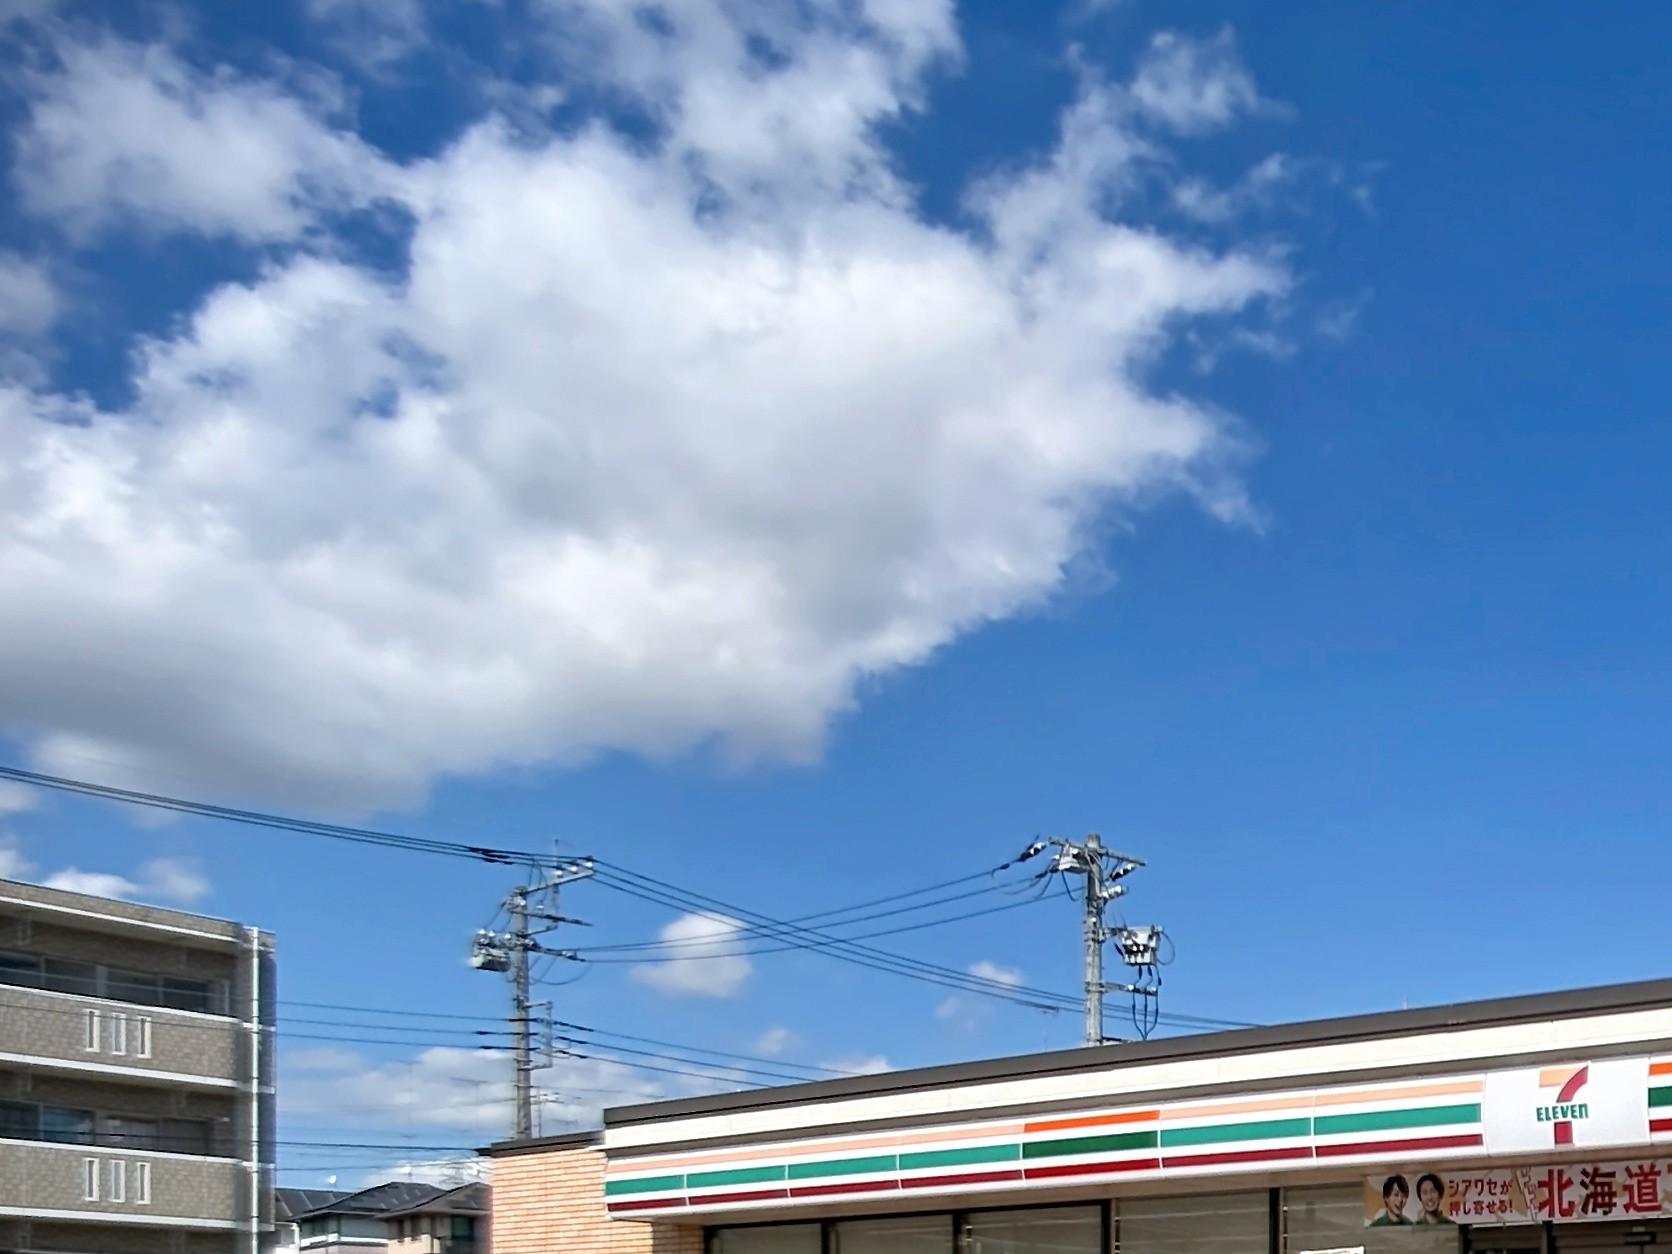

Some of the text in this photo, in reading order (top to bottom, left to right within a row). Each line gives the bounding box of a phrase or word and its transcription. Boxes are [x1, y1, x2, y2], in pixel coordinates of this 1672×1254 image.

[1448, 1178, 1512, 1198] シアワセが
